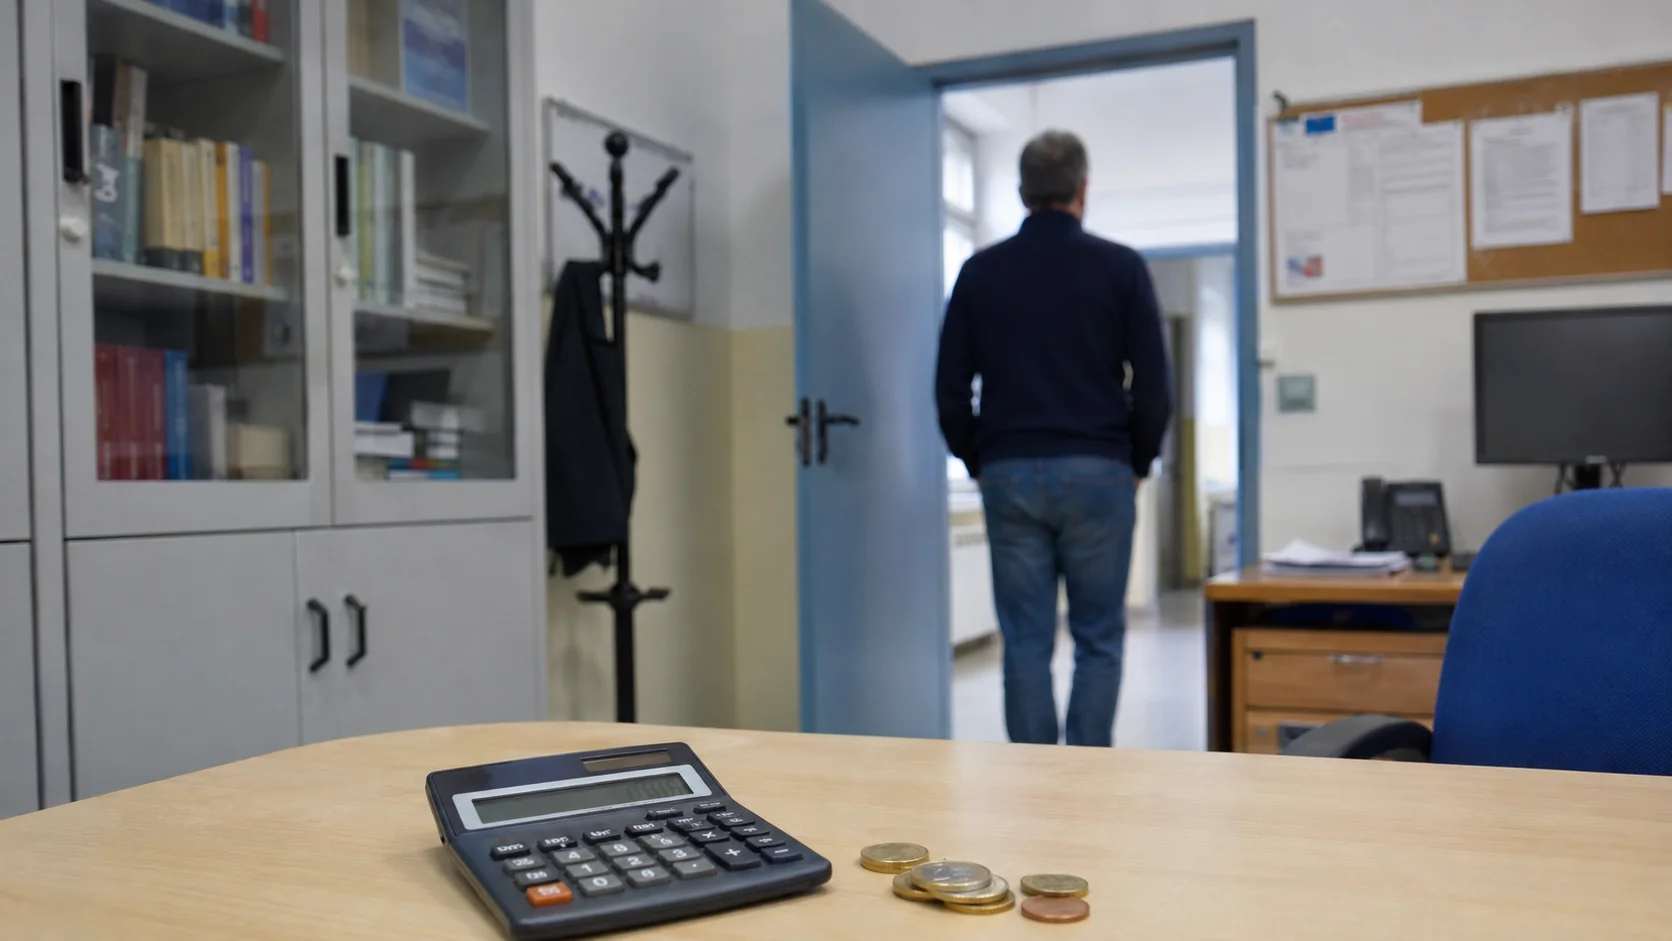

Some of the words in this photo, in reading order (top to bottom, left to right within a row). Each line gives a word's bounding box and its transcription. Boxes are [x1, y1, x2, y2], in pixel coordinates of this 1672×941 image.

[568, 851, 581, 859] 4
[673, 848, 687, 858] 3
[628, 856, 642, 866] 2
[581, 863, 593, 873] 1
[592, 876, 608, 887] 0
